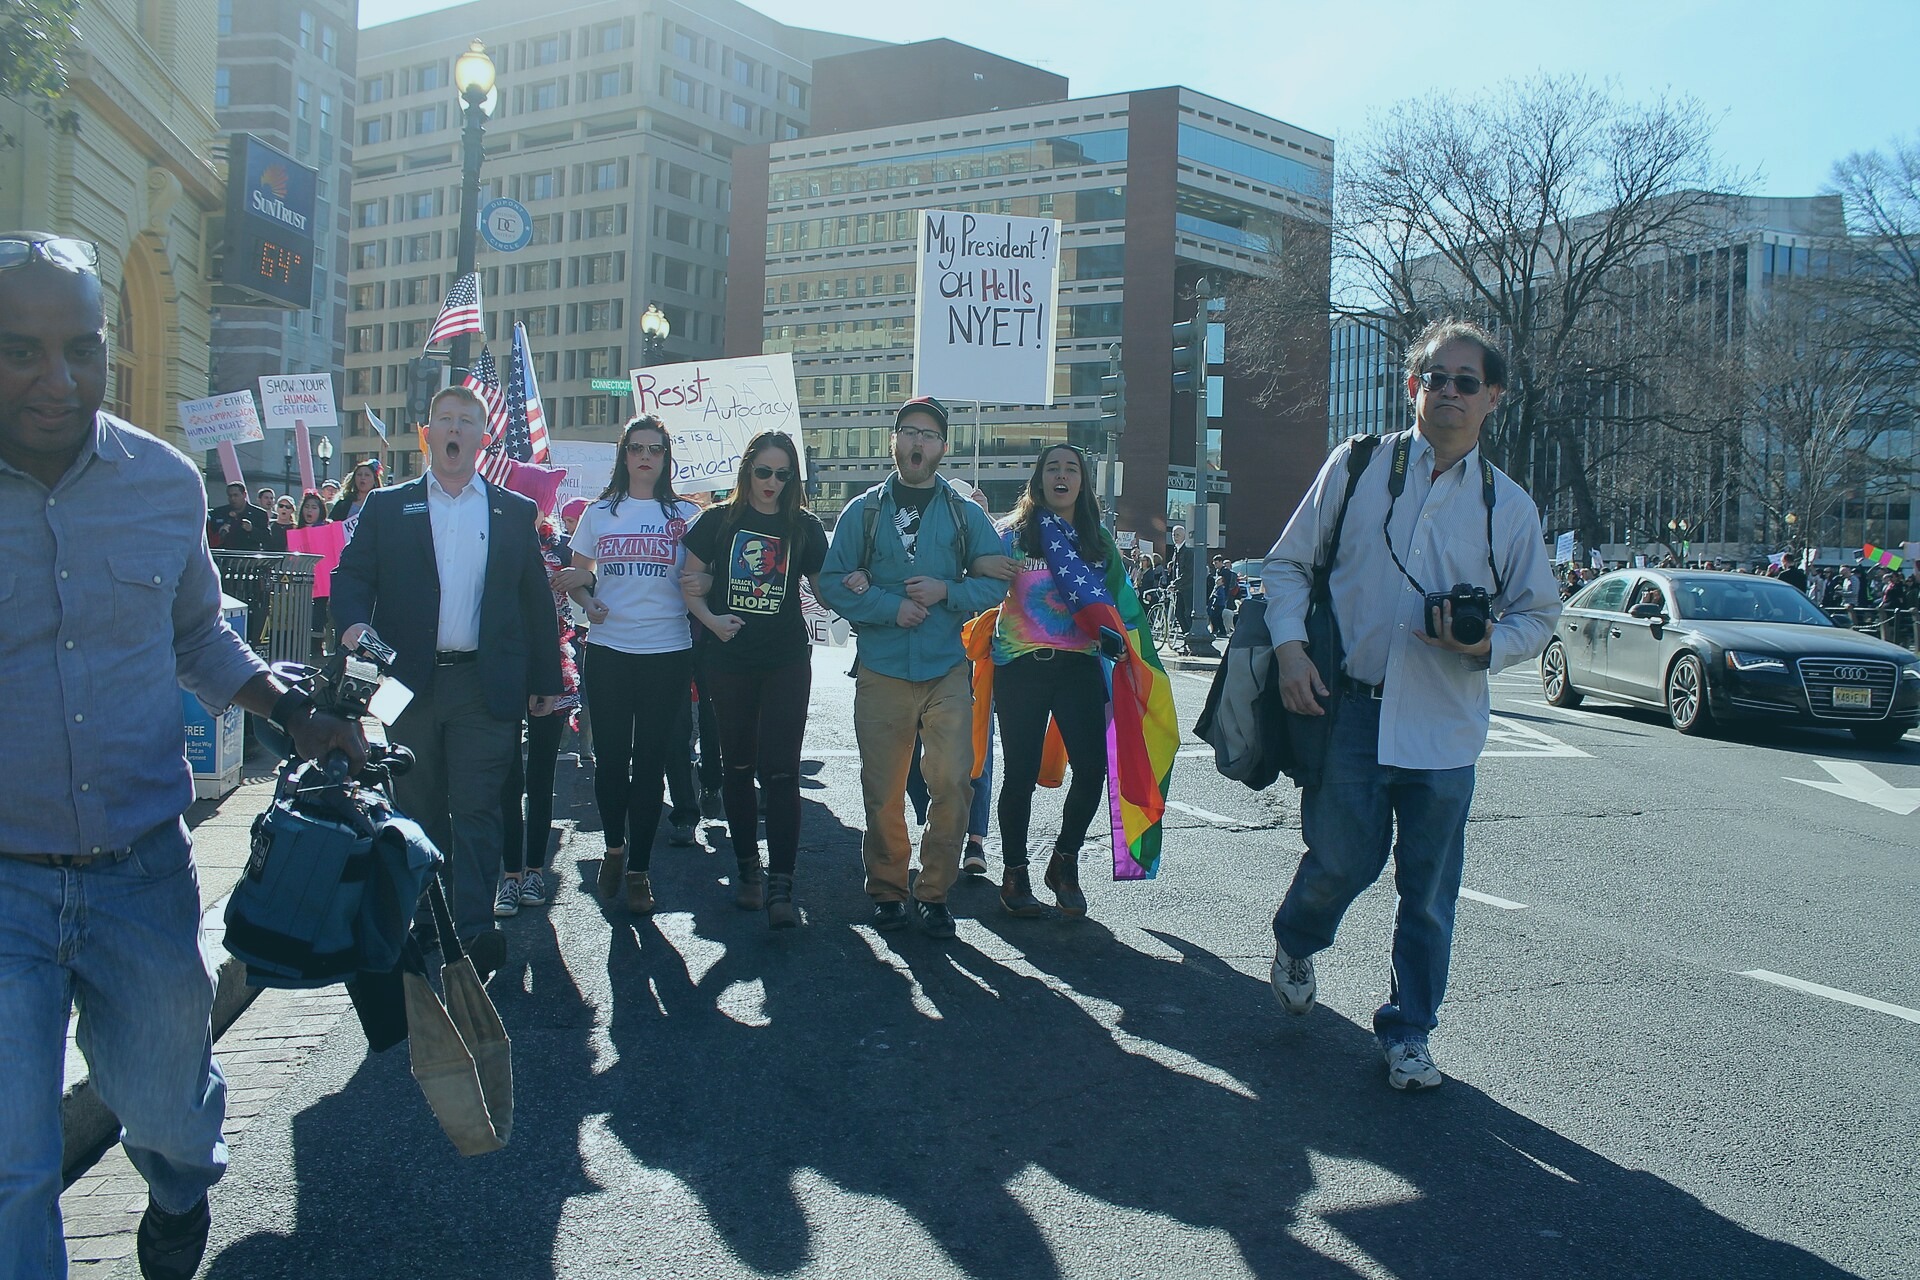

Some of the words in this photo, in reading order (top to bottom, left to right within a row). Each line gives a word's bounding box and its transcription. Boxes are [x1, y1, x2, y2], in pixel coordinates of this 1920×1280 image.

[491, 201, 524, 212] DUPONT
[490, 238, 519, 250] CIRCLE
[926, 214, 955, 270] My
[961, 214, 1049, 260] President?
[981, 267, 1033, 304] Hells
[948, 303, 1043, 349] NYET!
[267, 379, 295, 393] SHOW
[299, 380, 327, 391] YOUR
[591, 380, 631, 390] CONNECTICUT
[636, 367, 710, 413] Resist
[284, 394, 317, 404] HUMAN
[185, 402, 214, 413] TRUTH
[272, 404, 329, 415] CERTIFICATE
[187, 425, 216, 437] HUMAN
[691, 430, 703, 442] is
[706, 432, 721, 442] a
[671, 455, 742, 480] Democr
[1395, 450, 1406, 474] Nikon
[640, 525, 655, 533] I'M
[657, 525, 665, 533] A
[604, 563, 625, 576] AND
[628, 563, 633, 575] I
[636, 563, 669, 578] VOTE
[731, 578, 752, 587] BARACK
[732, 594, 781, 610] HOPE
